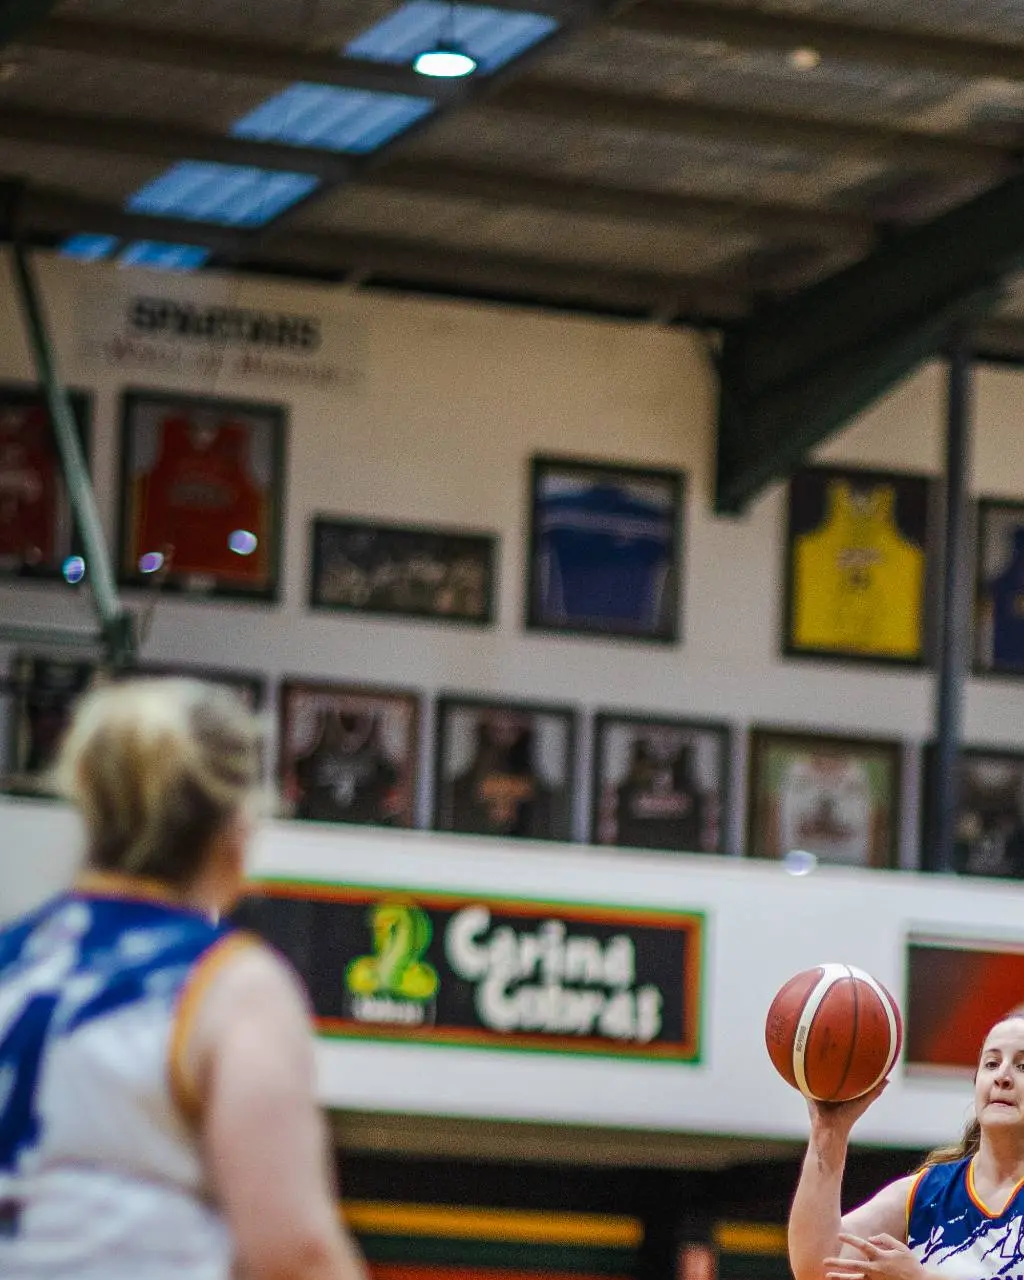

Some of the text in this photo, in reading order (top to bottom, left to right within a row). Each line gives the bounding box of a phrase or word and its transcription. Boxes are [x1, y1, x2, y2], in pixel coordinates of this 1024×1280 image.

[129, 297, 323, 351] SPARTANS
[445, 905, 636, 987] Carina
[476, 973, 663, 1043] Cobras
